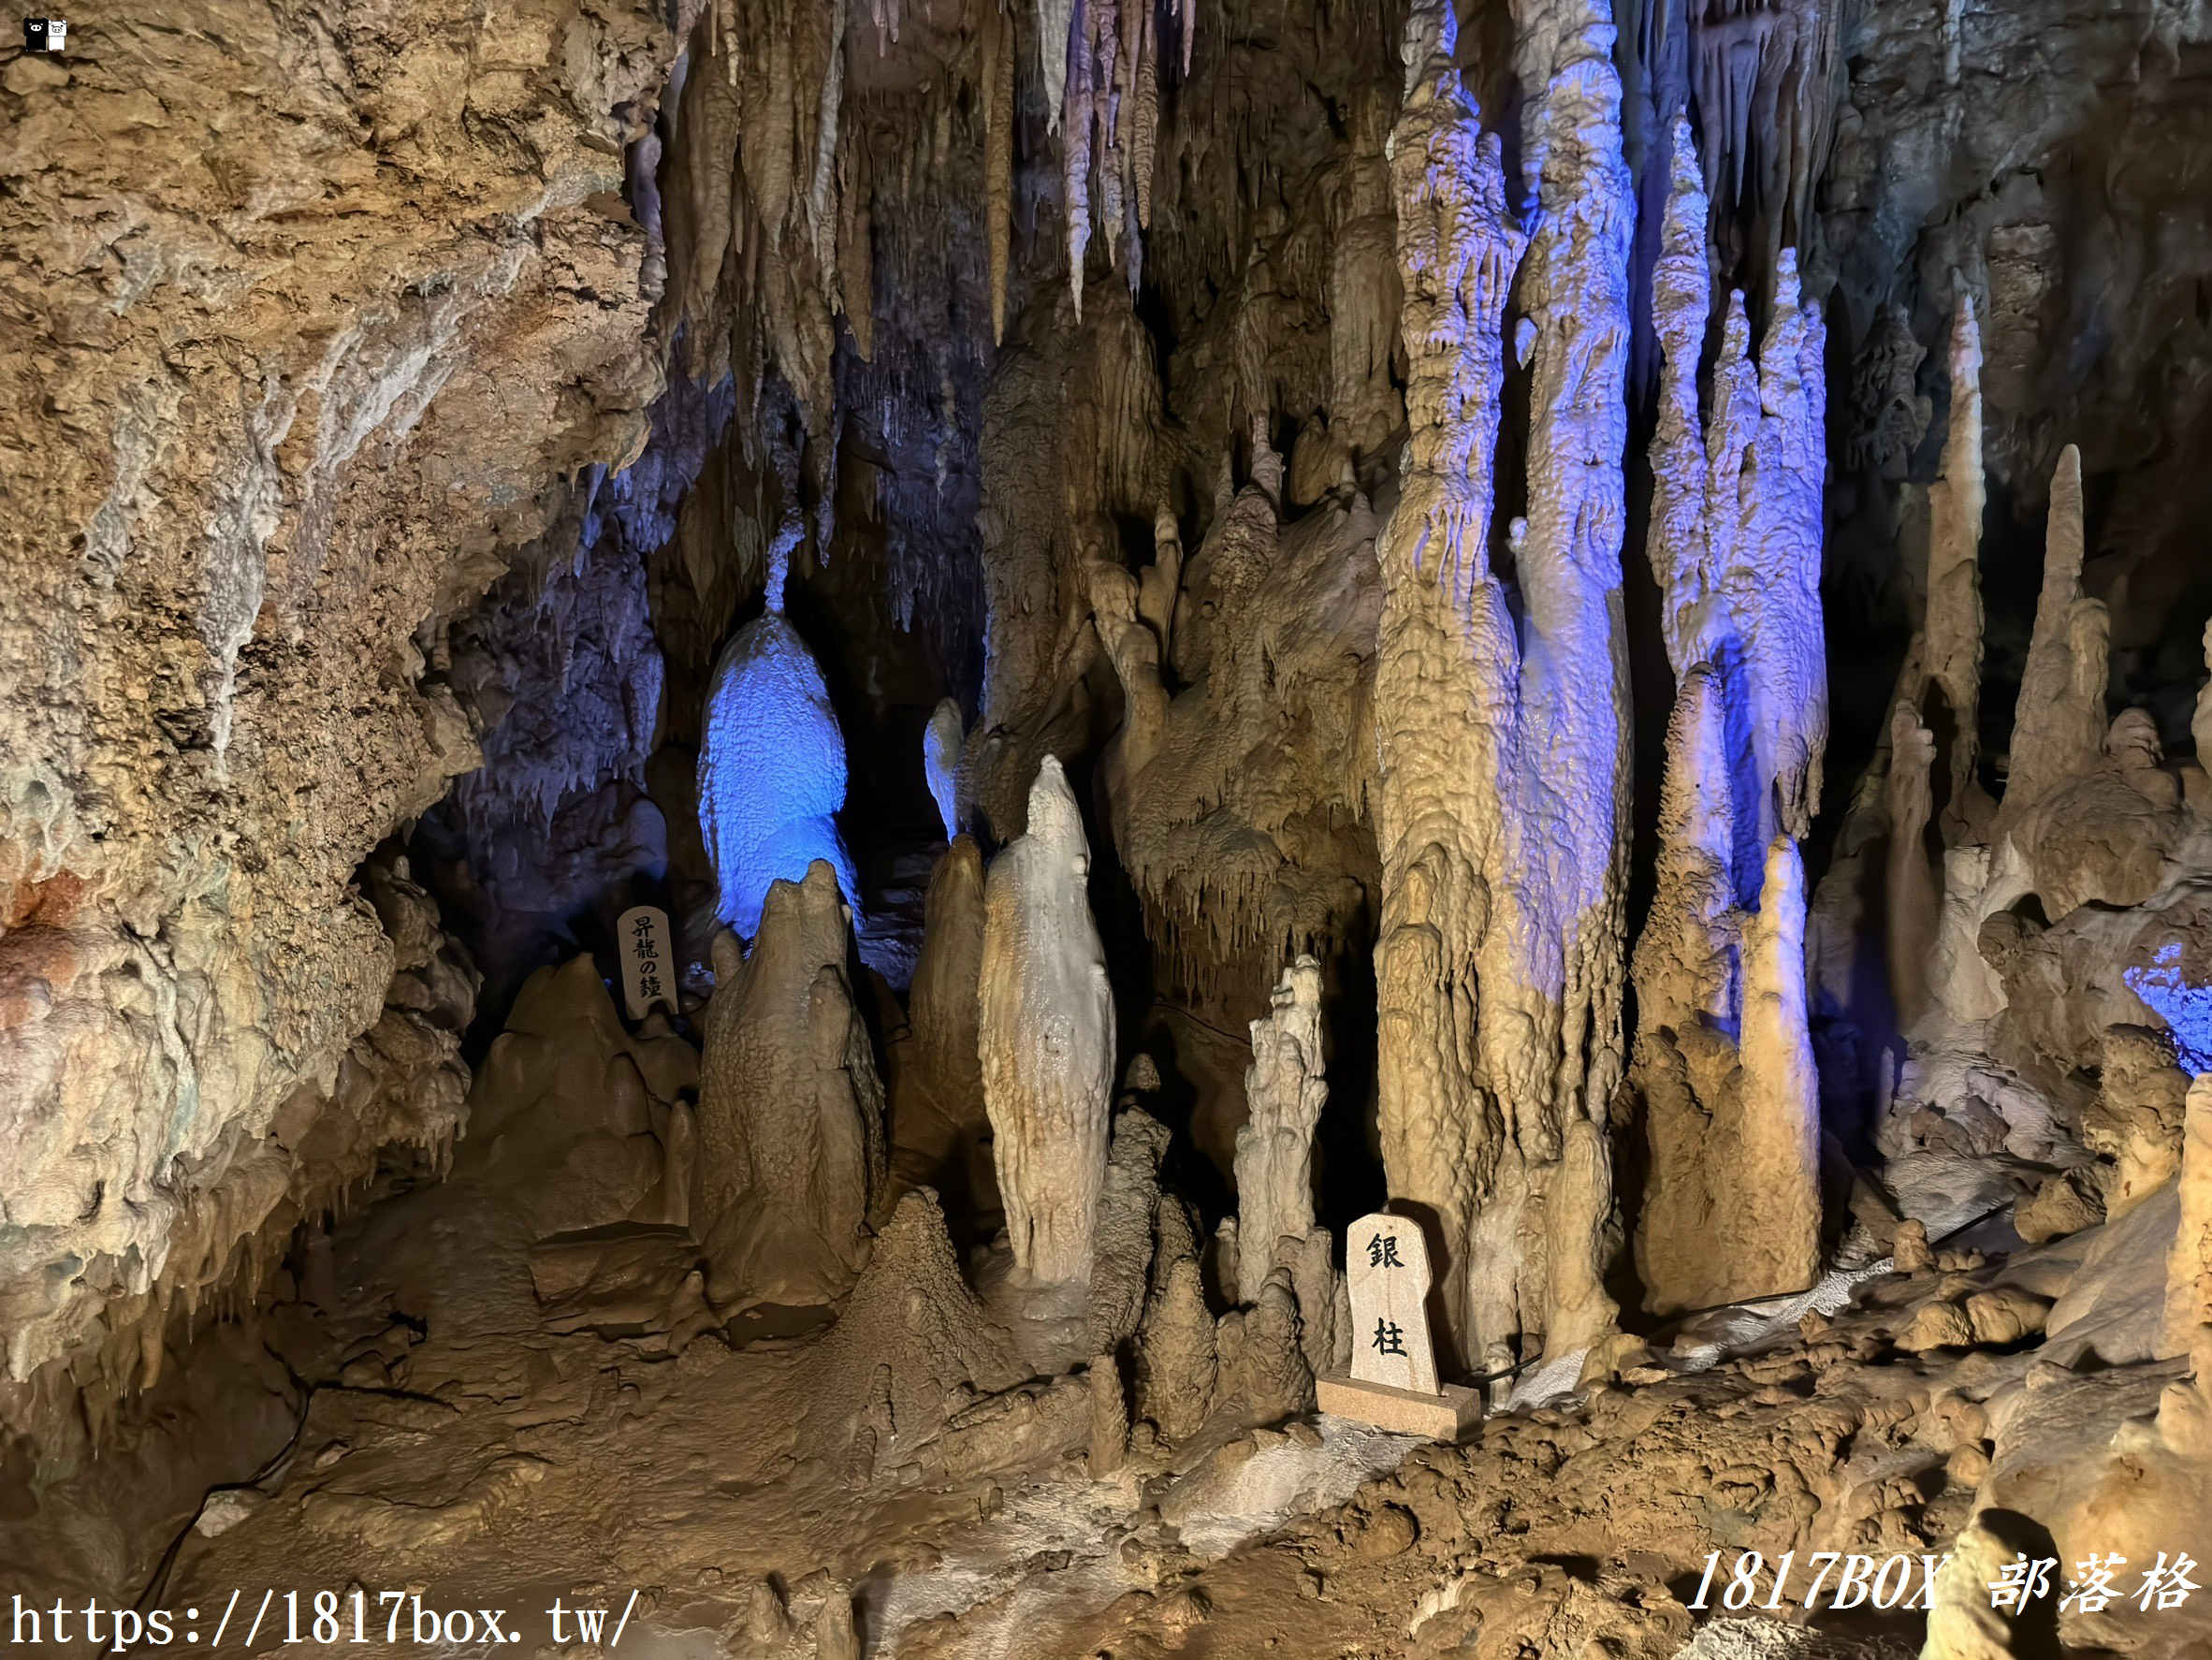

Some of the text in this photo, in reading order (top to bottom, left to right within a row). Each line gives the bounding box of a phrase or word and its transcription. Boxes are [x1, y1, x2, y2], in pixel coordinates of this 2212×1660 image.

[632, 916, 662, 997] 昇龍の鐘
[1366, 1232, 1408, 1358] 銀柱
